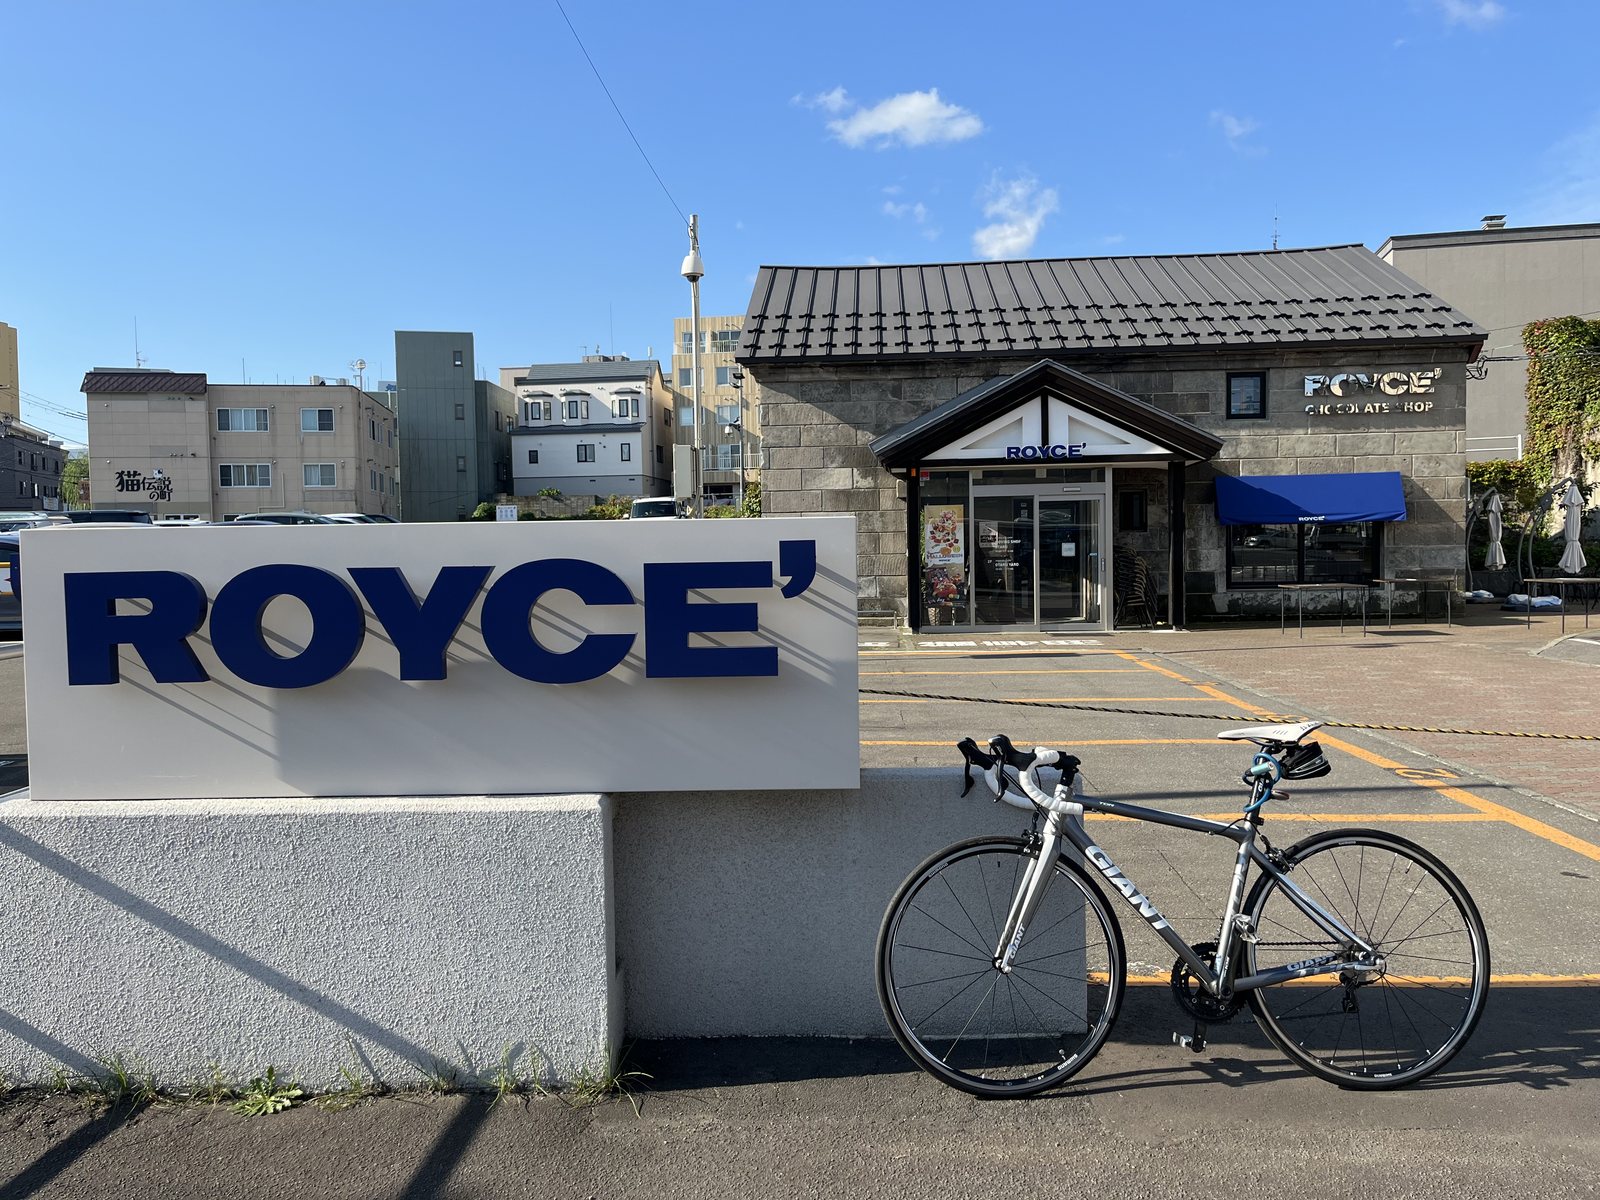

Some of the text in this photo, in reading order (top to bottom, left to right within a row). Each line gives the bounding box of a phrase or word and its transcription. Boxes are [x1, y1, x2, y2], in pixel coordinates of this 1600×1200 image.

[1006, 442, 1087, 460] ROYCE'
[63, 539, 818, 689] ROYCE'
[1084, 845, 1168, 930] GIANT
[1010, 922, 1025, 959] GIANT
